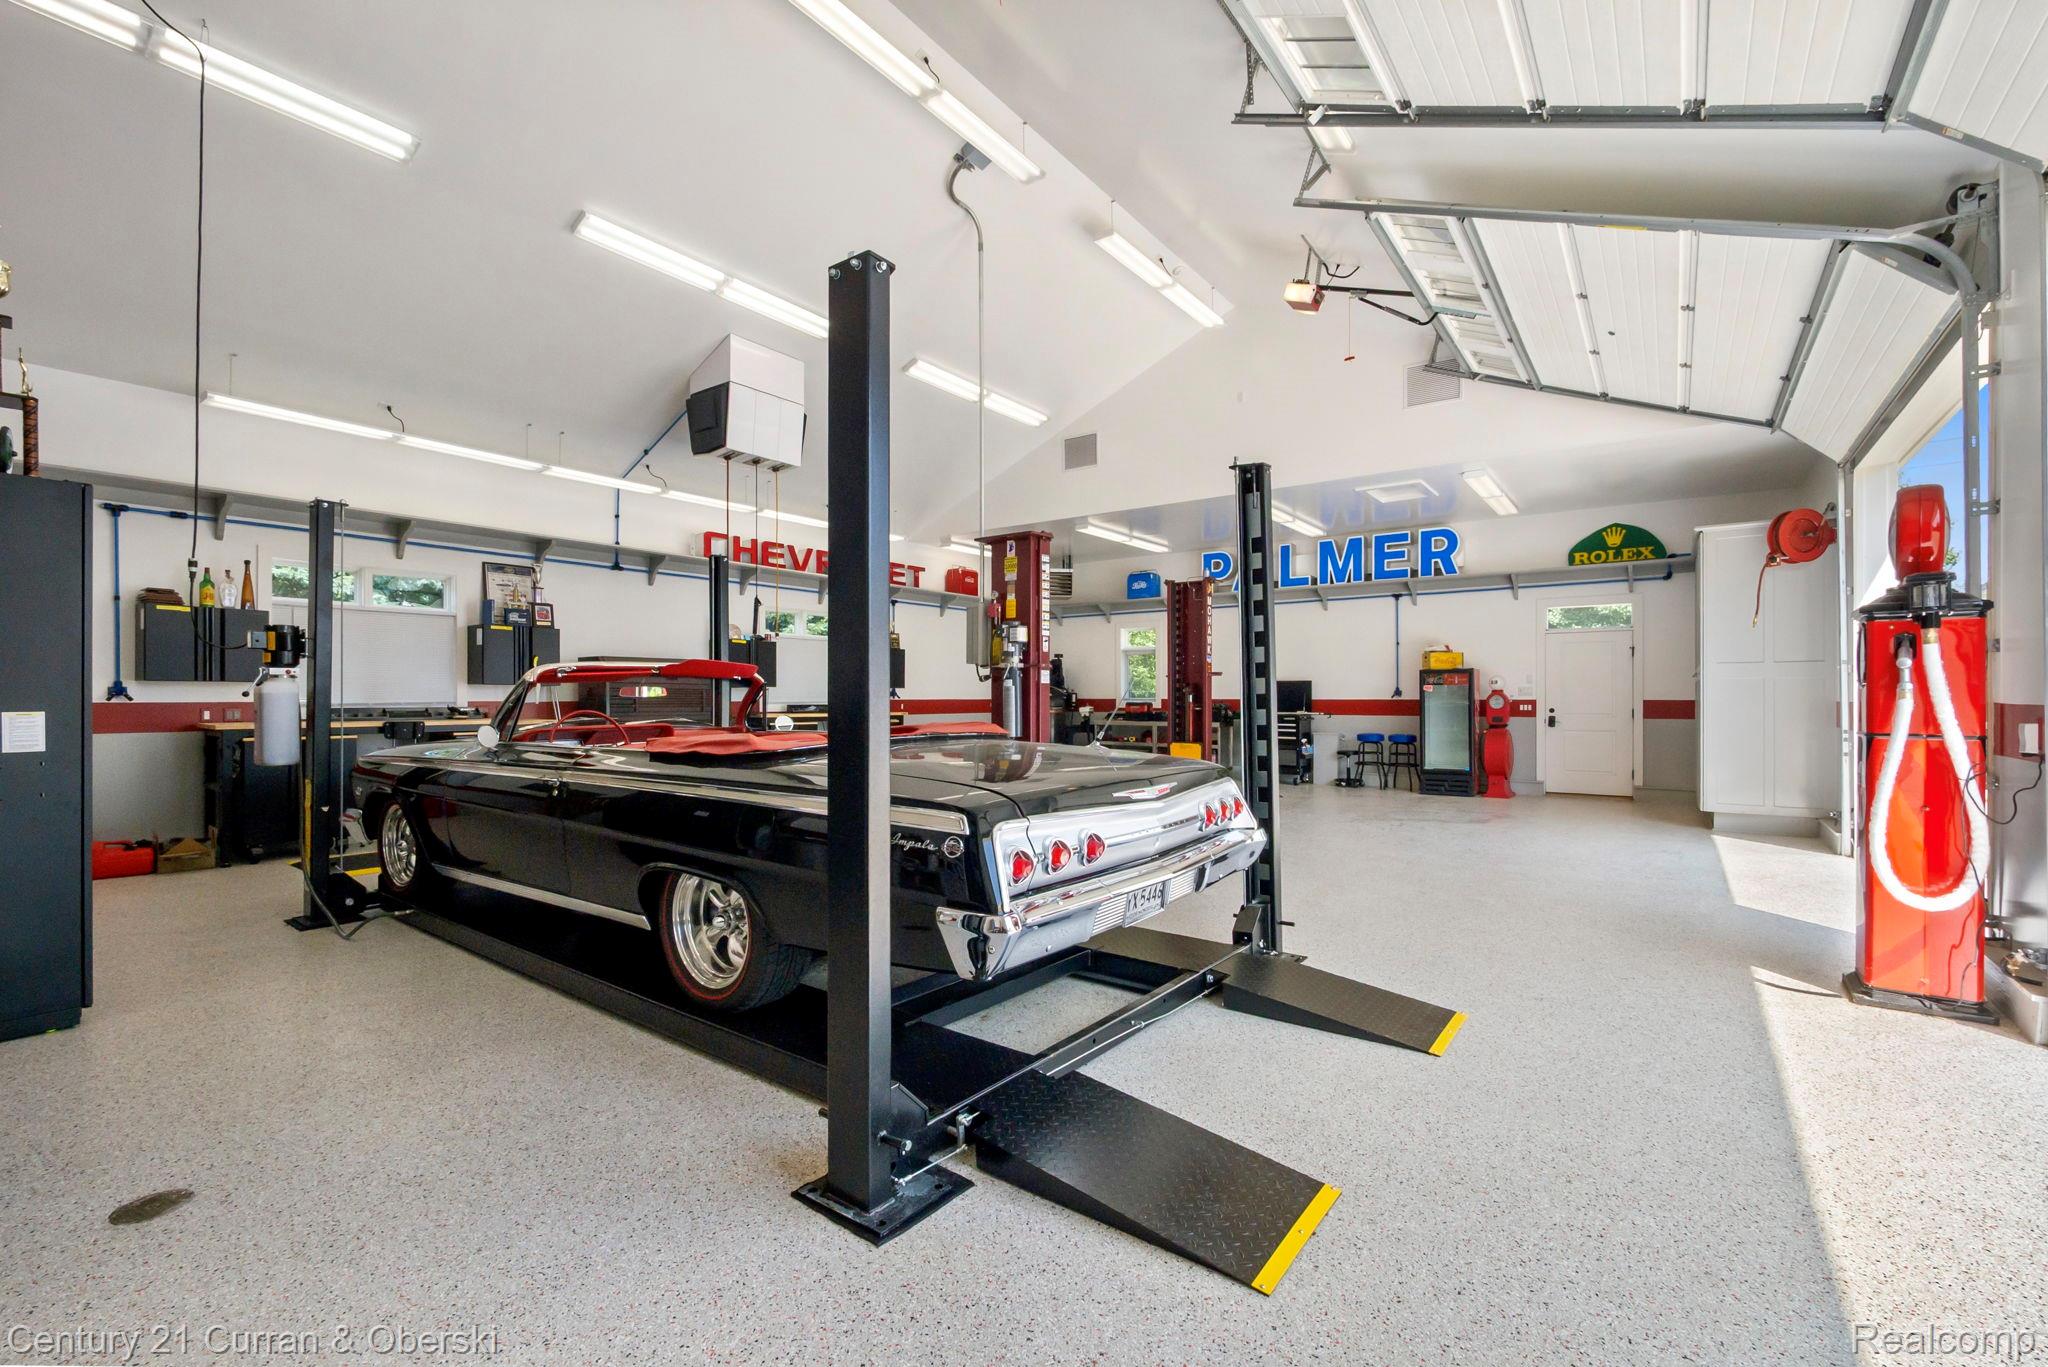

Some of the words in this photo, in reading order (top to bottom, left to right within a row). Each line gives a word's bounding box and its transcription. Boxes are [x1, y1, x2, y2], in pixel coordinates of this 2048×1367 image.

[1201, 527, 1460, 592] PLMER
[1573, 546, 1656, 565] ROLEX
[891, 832, 938, 851] Impala
